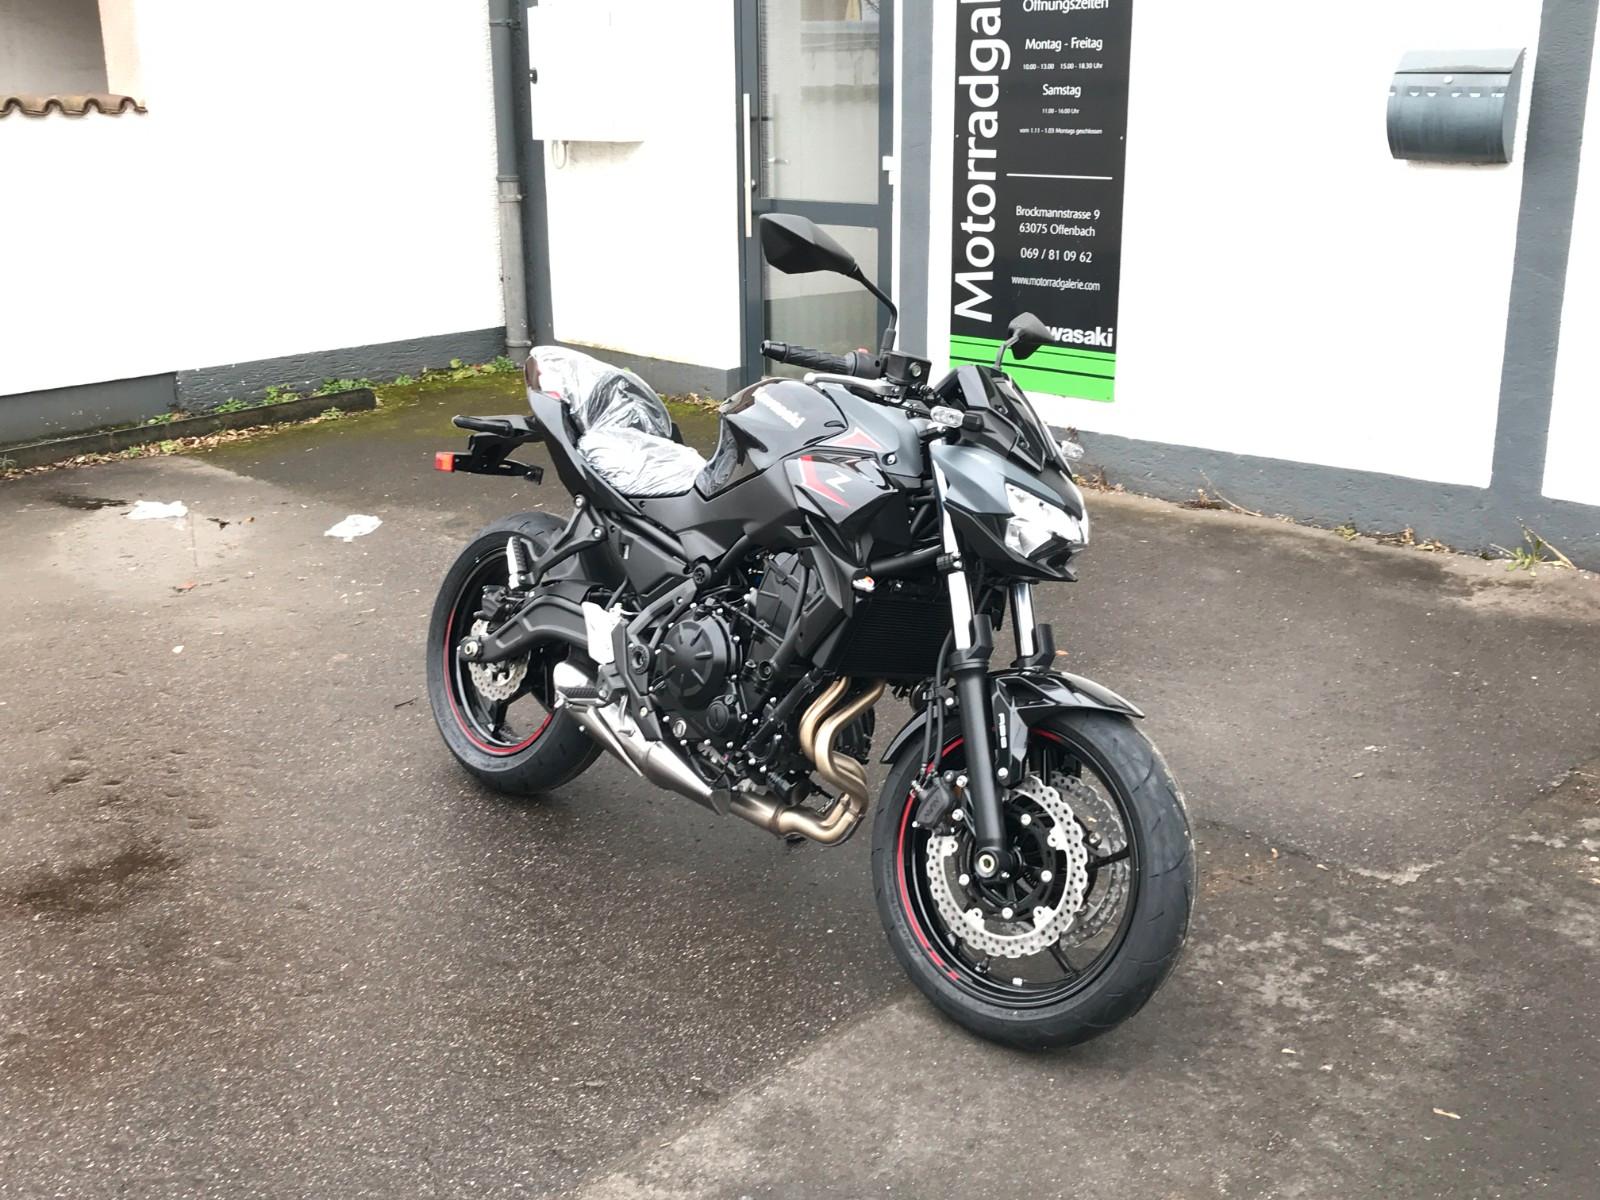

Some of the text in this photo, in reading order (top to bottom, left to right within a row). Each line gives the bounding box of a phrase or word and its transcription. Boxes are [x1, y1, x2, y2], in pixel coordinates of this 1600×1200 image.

[1025, 38, 1062, 52] Montag
[1070, 37, 1103, 51] Freitag
[1042, 83, 1082, 98] Samstag
[1016, 205, 1101, 220] Brockmannstrasse 9
[1019, 223, 1096, 237] 63075 Offenbach
[1020, 248, 1039, 259] 069
[1049, 250, 1060, 261] 81
[1064, 251, 1076, 262] 09
[1079, 251, 1093, 263] 62
[1011, 275, 1101, 291] www.motorradgalerie.com
[1046, 326, 1113, 347] wasaki
